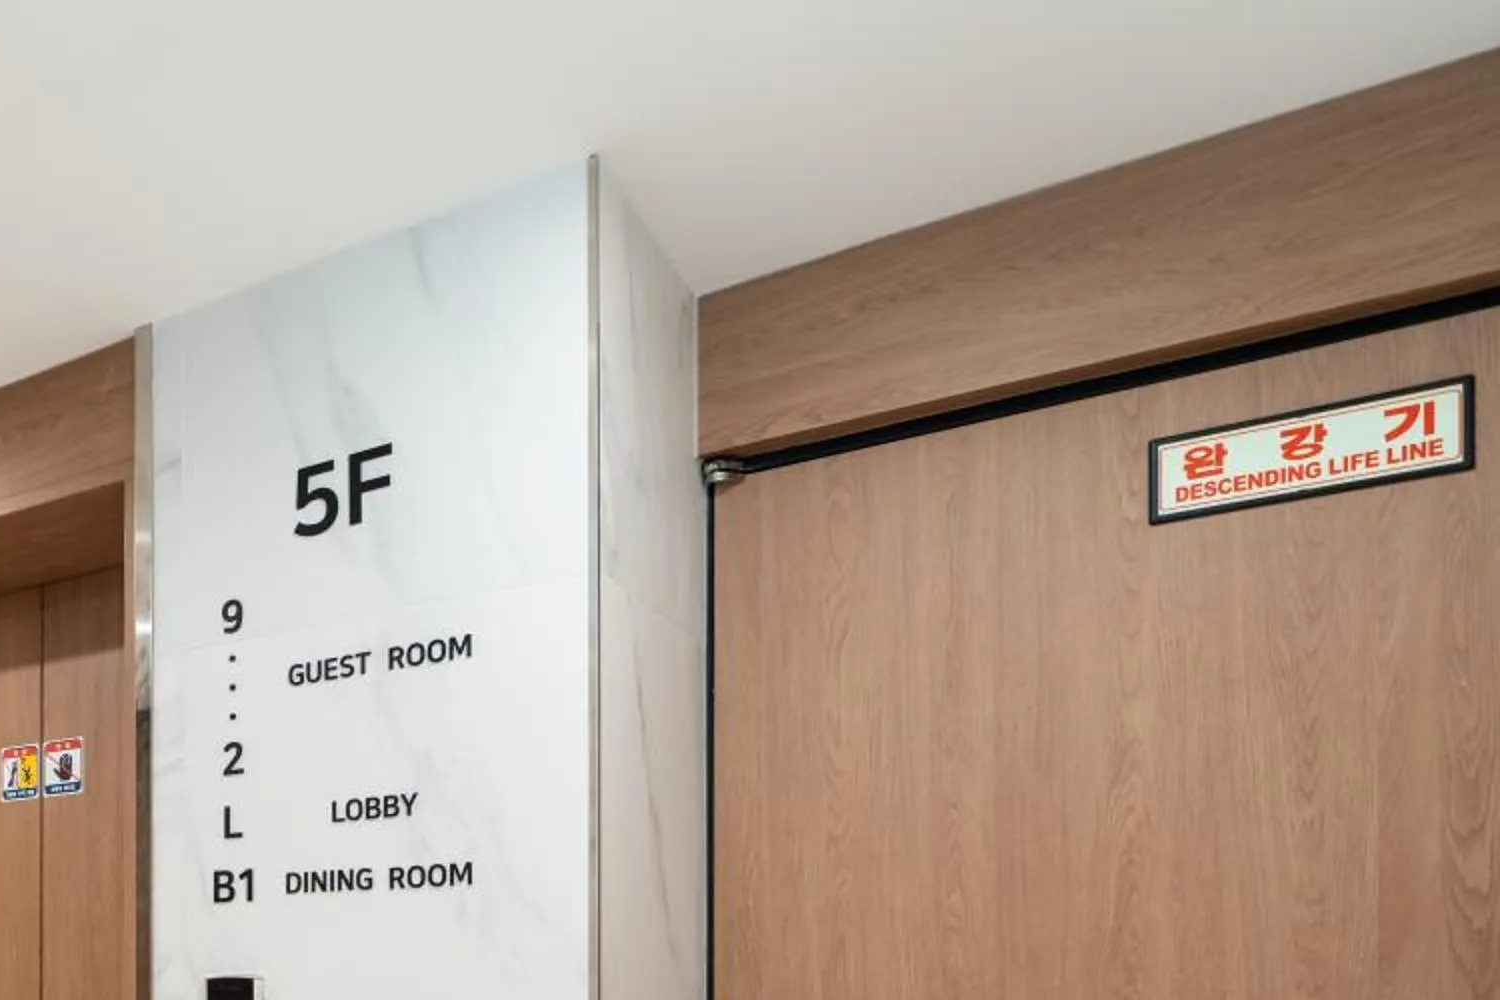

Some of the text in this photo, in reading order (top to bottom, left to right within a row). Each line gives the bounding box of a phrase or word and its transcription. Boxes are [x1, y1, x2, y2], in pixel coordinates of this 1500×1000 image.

[293, 442, 393, 538] 5F
[1175, 437, 1444, 503] DESCENDING LIFE LINE
[221, 599, 243, 635] 9
[288, 633, 473, 687] GUEST ROOM
[222, 741, 245, 777] 2
[223, 792, 418, 840] L LOBBY
[213, 861, 473, 904] B1 DINING ROOM
